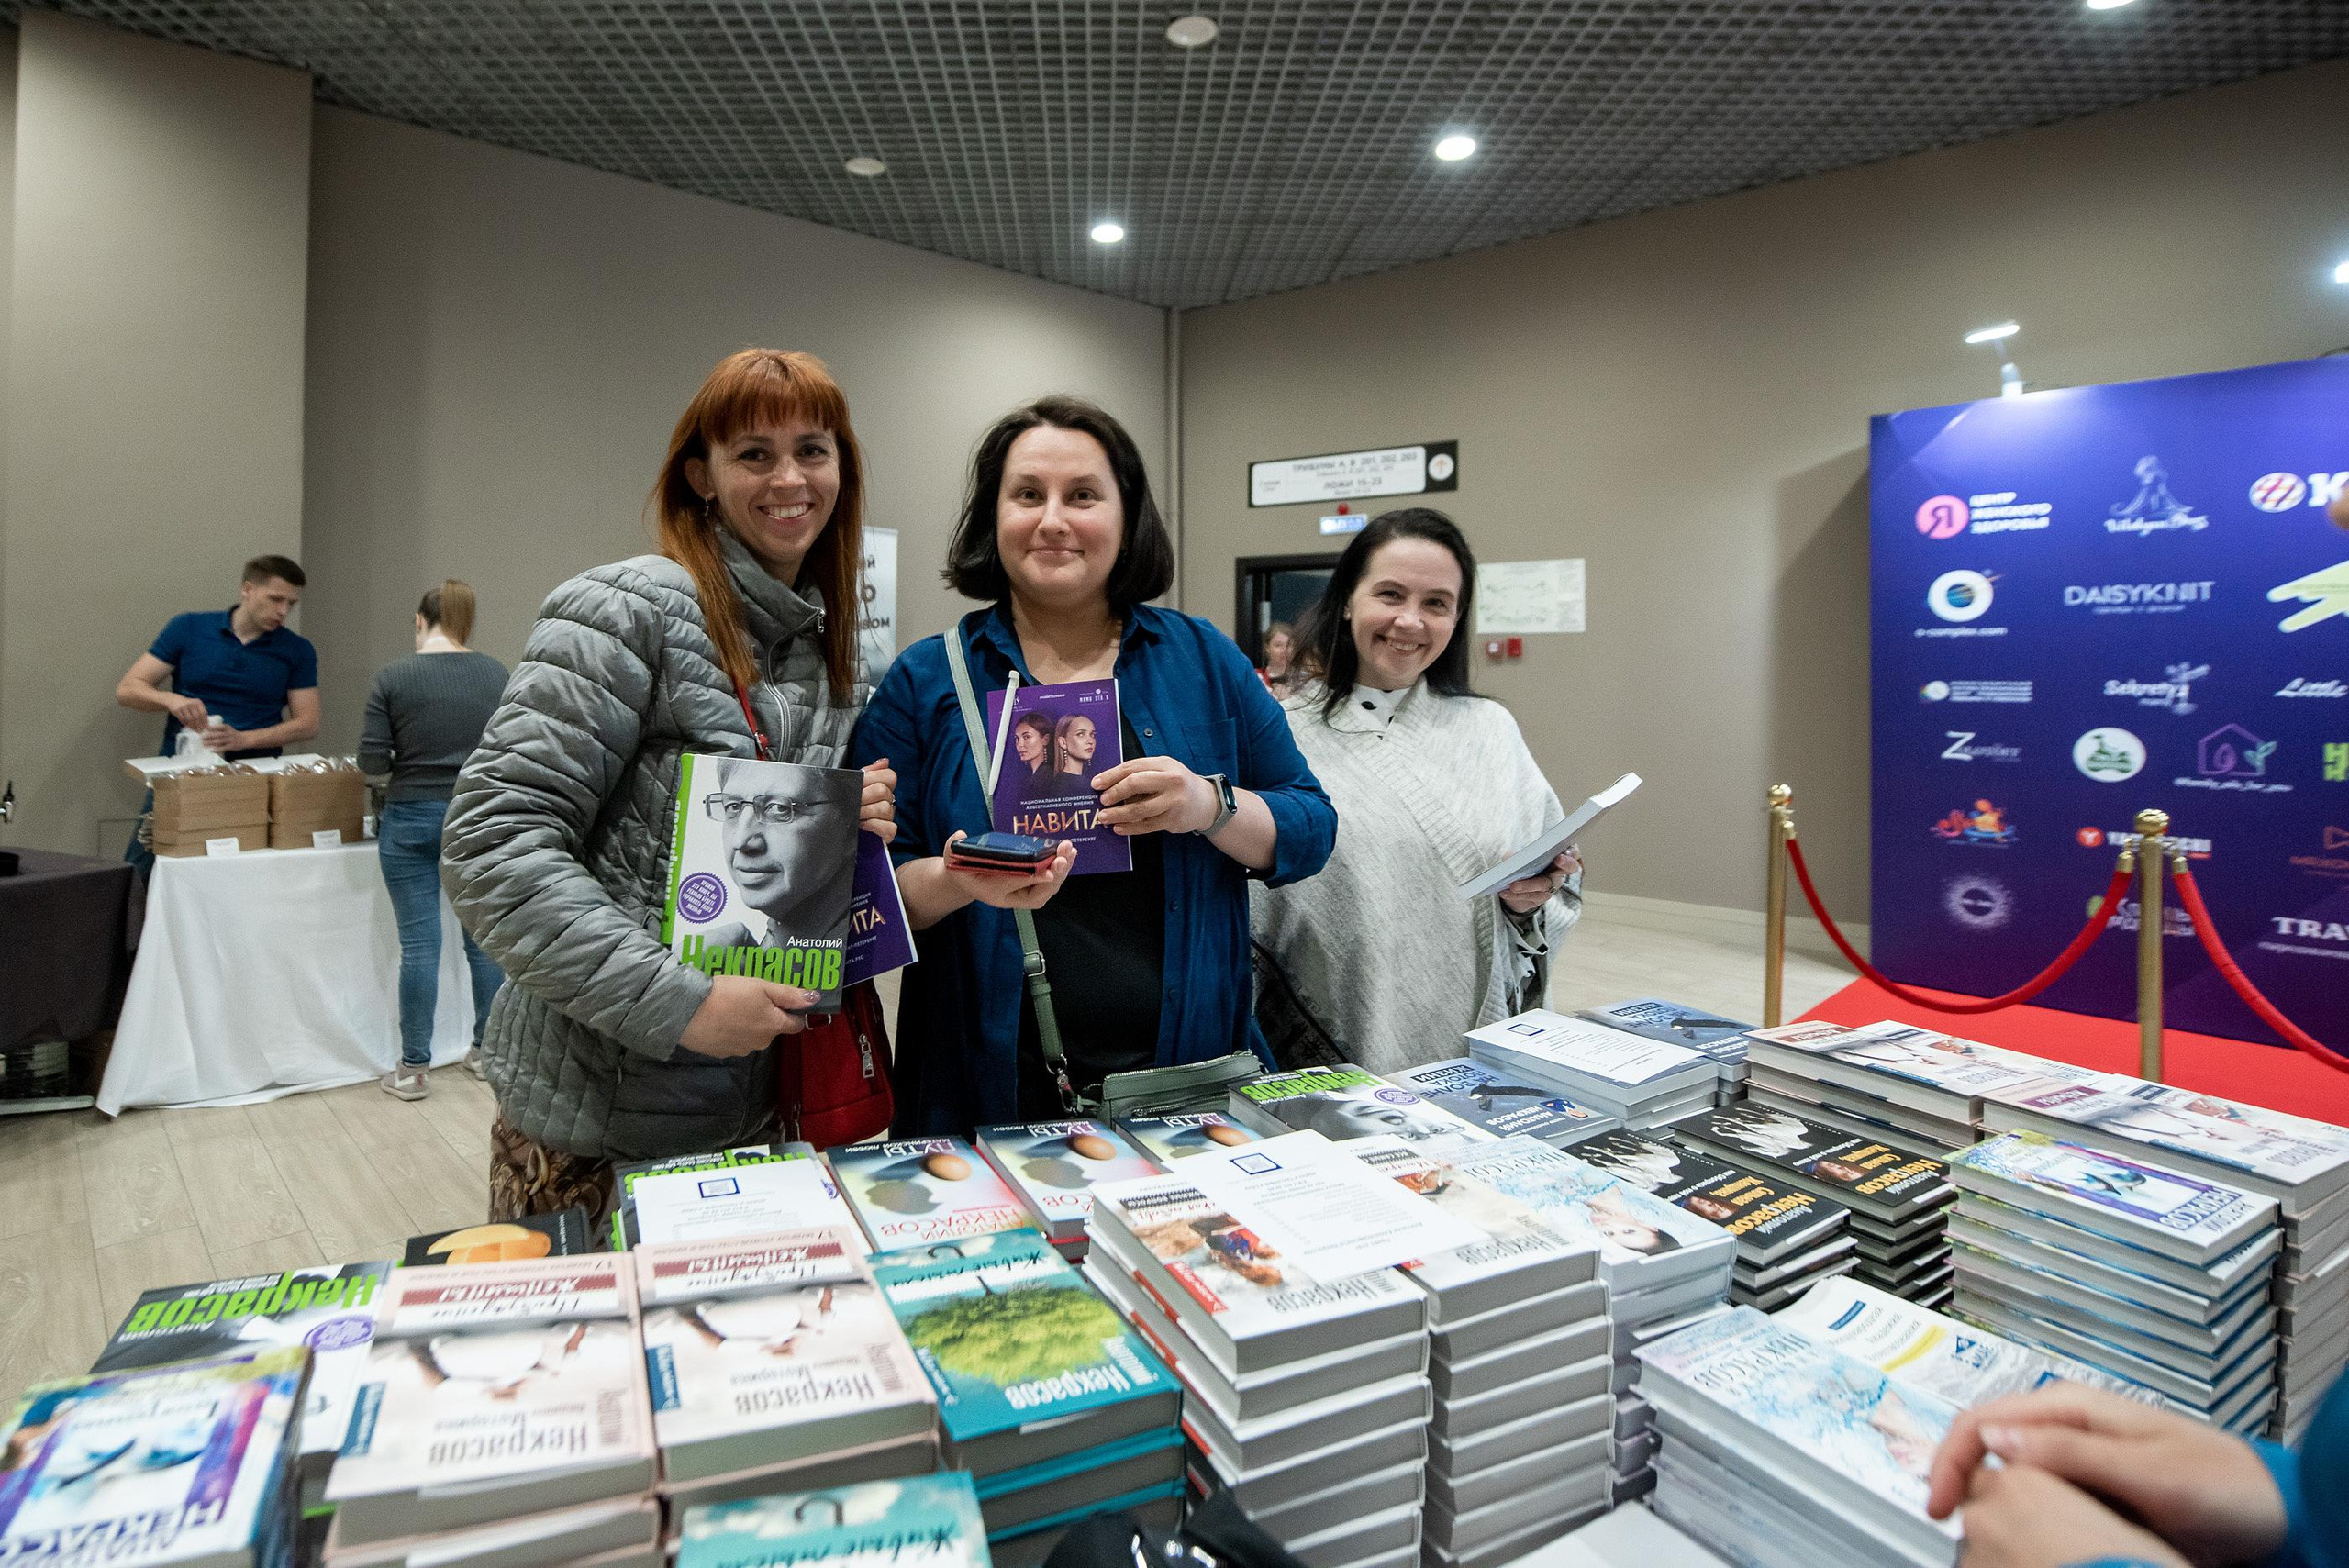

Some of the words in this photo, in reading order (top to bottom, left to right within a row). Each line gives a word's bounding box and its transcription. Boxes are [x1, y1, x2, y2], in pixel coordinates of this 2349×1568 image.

[1020, 796, 1062, 806] НАЦИОНАЛЬНАЯ
[1026, 802, 1072, 810] АЛЬТЕРНАТИВНОГО
[1013, 808, 1108, 835] НАВИТА
[2271, 917, 2349, 941] TRA
[786, 935, 843, 949] Анатолий
[680, 934, 842, 991] Некрасов
[1414, 1065, 1468, 1082] ЖИЗНИ
[1430, 1071, 1486, 1085] ПОТОКА
[1239, 1069, 1383, 1102] Некрасов
[1419, 1080, 1473, 1099] ВОЛНЕ
[1026, 1119, 1090, 1130] МАТЕРИНСКОЙ
[1160, 1112, 1218, 1121] МАТЕРИНСКОЙ
[1166, 1113, 1228, 1129] ПУТЫ
[1486, 1106, 1543, 1126] НЕКРАСОВ
[1499, 1111, 1553, 1131] АНАТОЛИЙ
[1029, 1120, 1097, 1138] ПУТЫ
[844, 1143, 880, 1153] ЛЮБВИ
[882, 1138, 951, 1150] МАТЕРИНСКОЙ
[884, 1141, 957, 1158] ПУТЫ
[1855, 1158, 1943, 1195] Некрасов
[1884, 1170, 1940, 1195] Анатолий
[1724, 1191, 1817, 1236] Некрасов
[2157, 1189, 2244, 1230] НЕКРАСОВ
[126, 1270, 378, 1334] Некрасов
[734, 1373, 875, 1418] Некрасов
[1004, 1363, 1131, 1410] Некрасов
[429, 1425, 589, 1463] Некрасов
